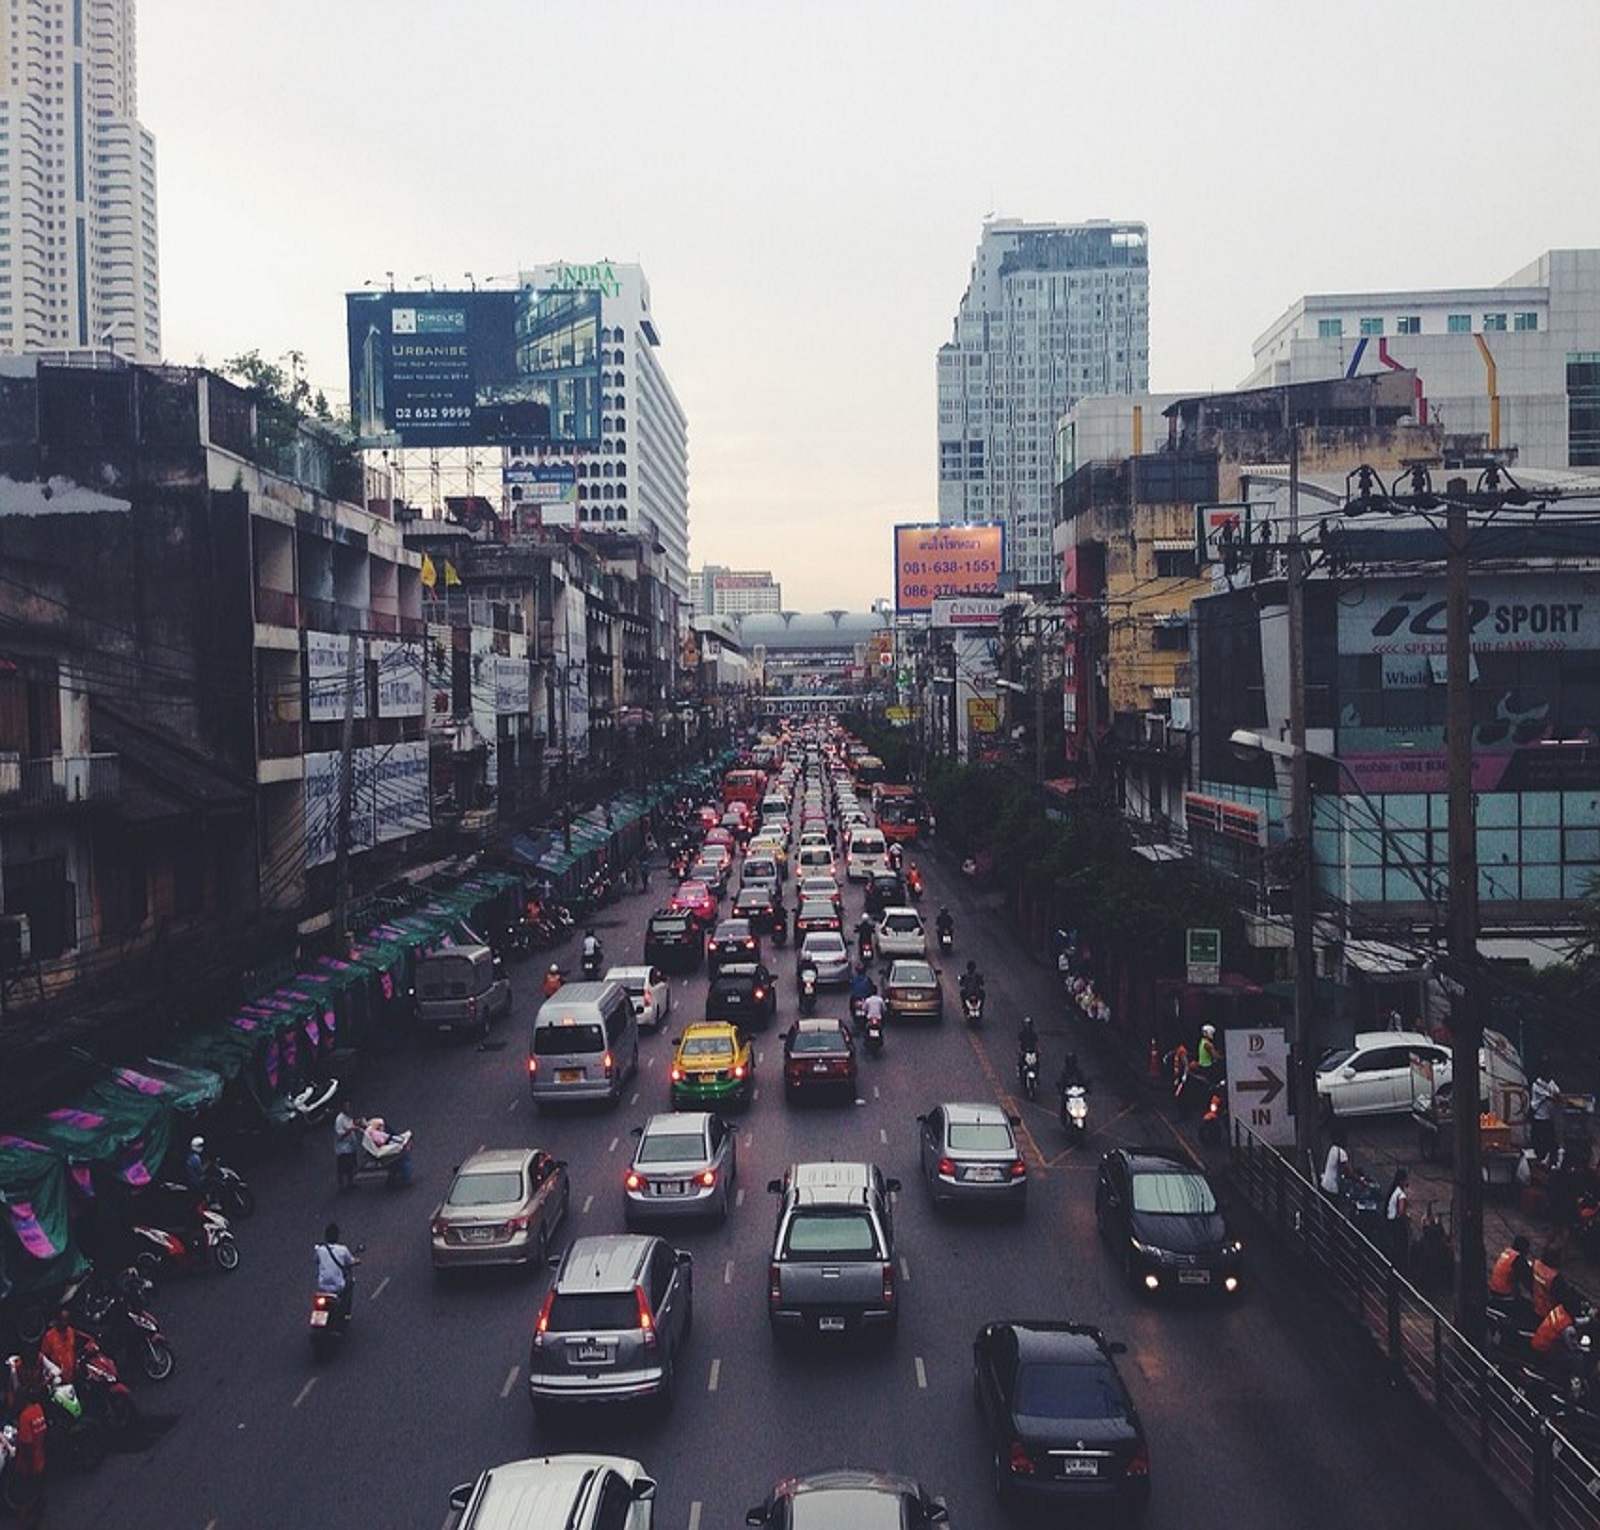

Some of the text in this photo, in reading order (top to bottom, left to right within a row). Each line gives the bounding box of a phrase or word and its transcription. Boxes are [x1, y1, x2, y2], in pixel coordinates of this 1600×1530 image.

[557, 266, 615, 282] INDRA
[395, 406, 472, 420] 02 652 9999
[1494, 603, 1584, 634] SPORT
[1251, 1109, 1271, 1126] IN
